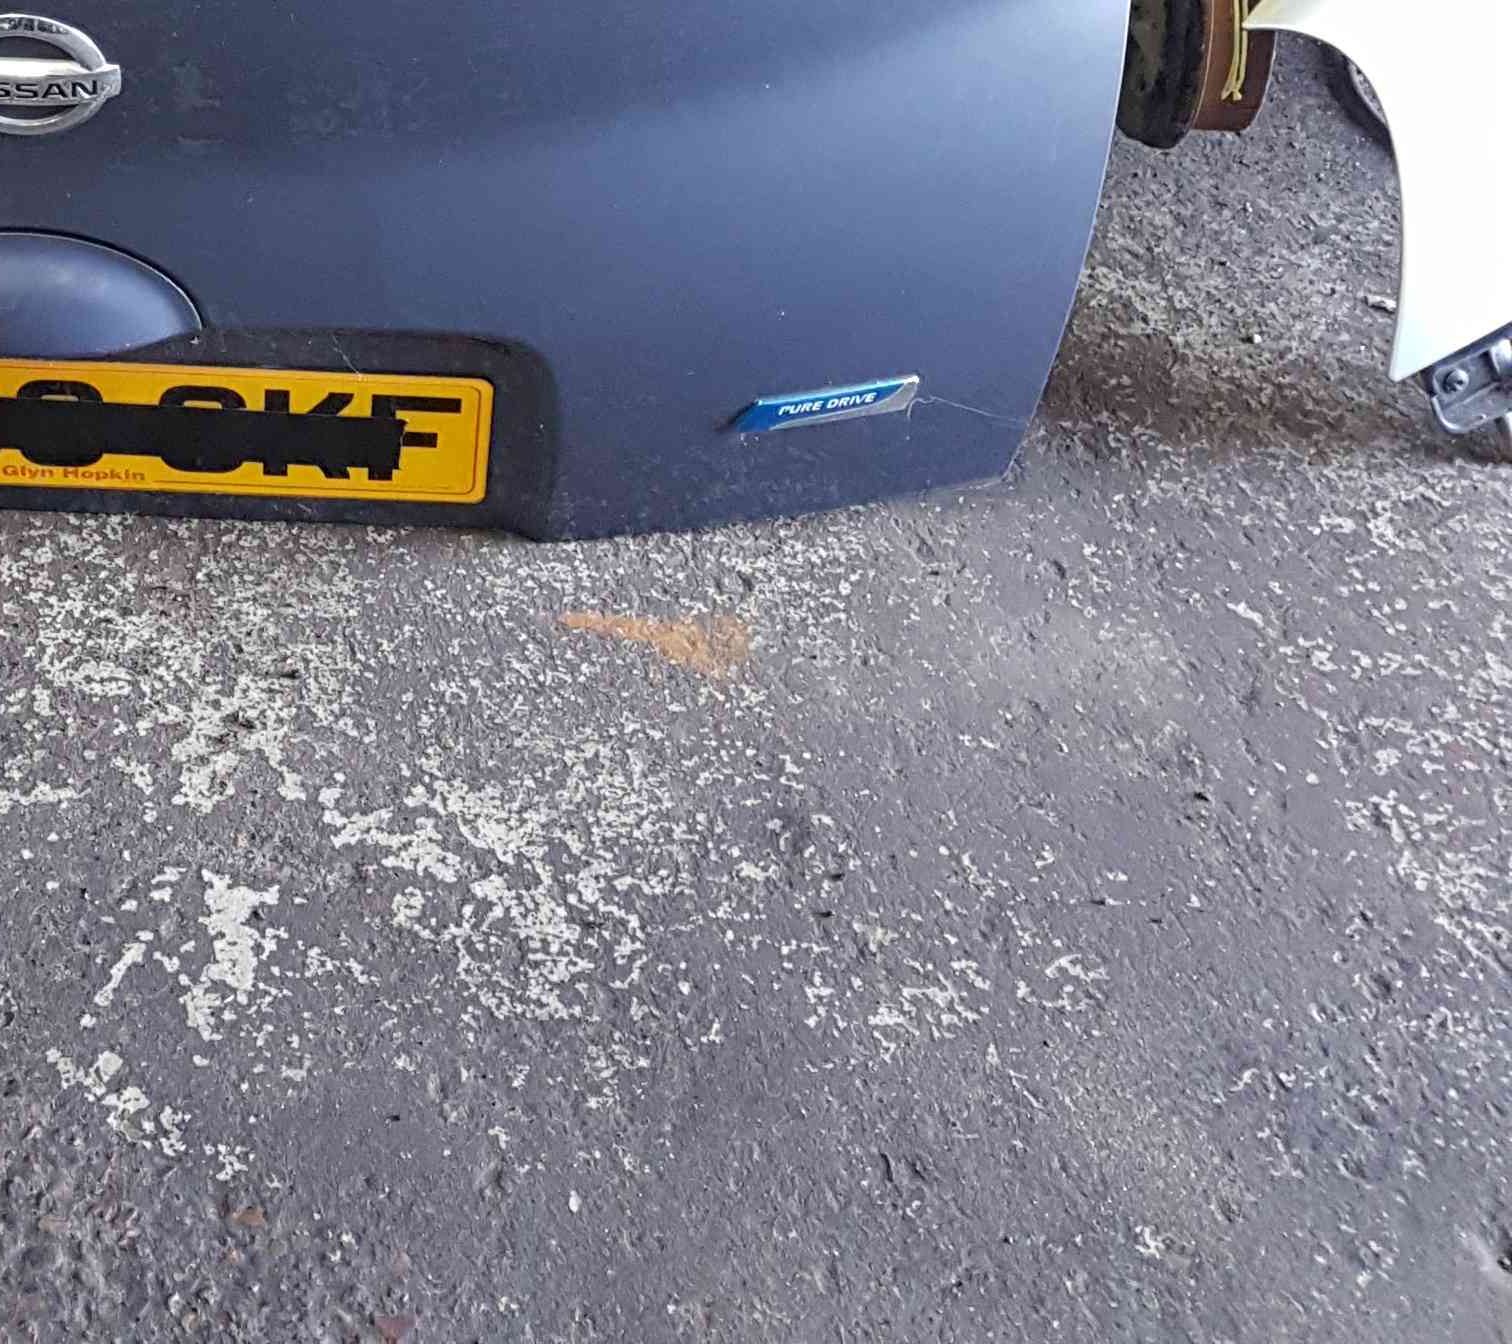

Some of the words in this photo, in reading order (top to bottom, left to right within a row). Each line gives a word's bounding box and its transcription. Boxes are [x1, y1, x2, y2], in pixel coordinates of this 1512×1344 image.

[778, 400, 824, 416] PURE
[826, 392, 878, 409] DRIVE
[2, 465, 54, 480] Glyn
[62, 467, 146, 481] Hopkin
